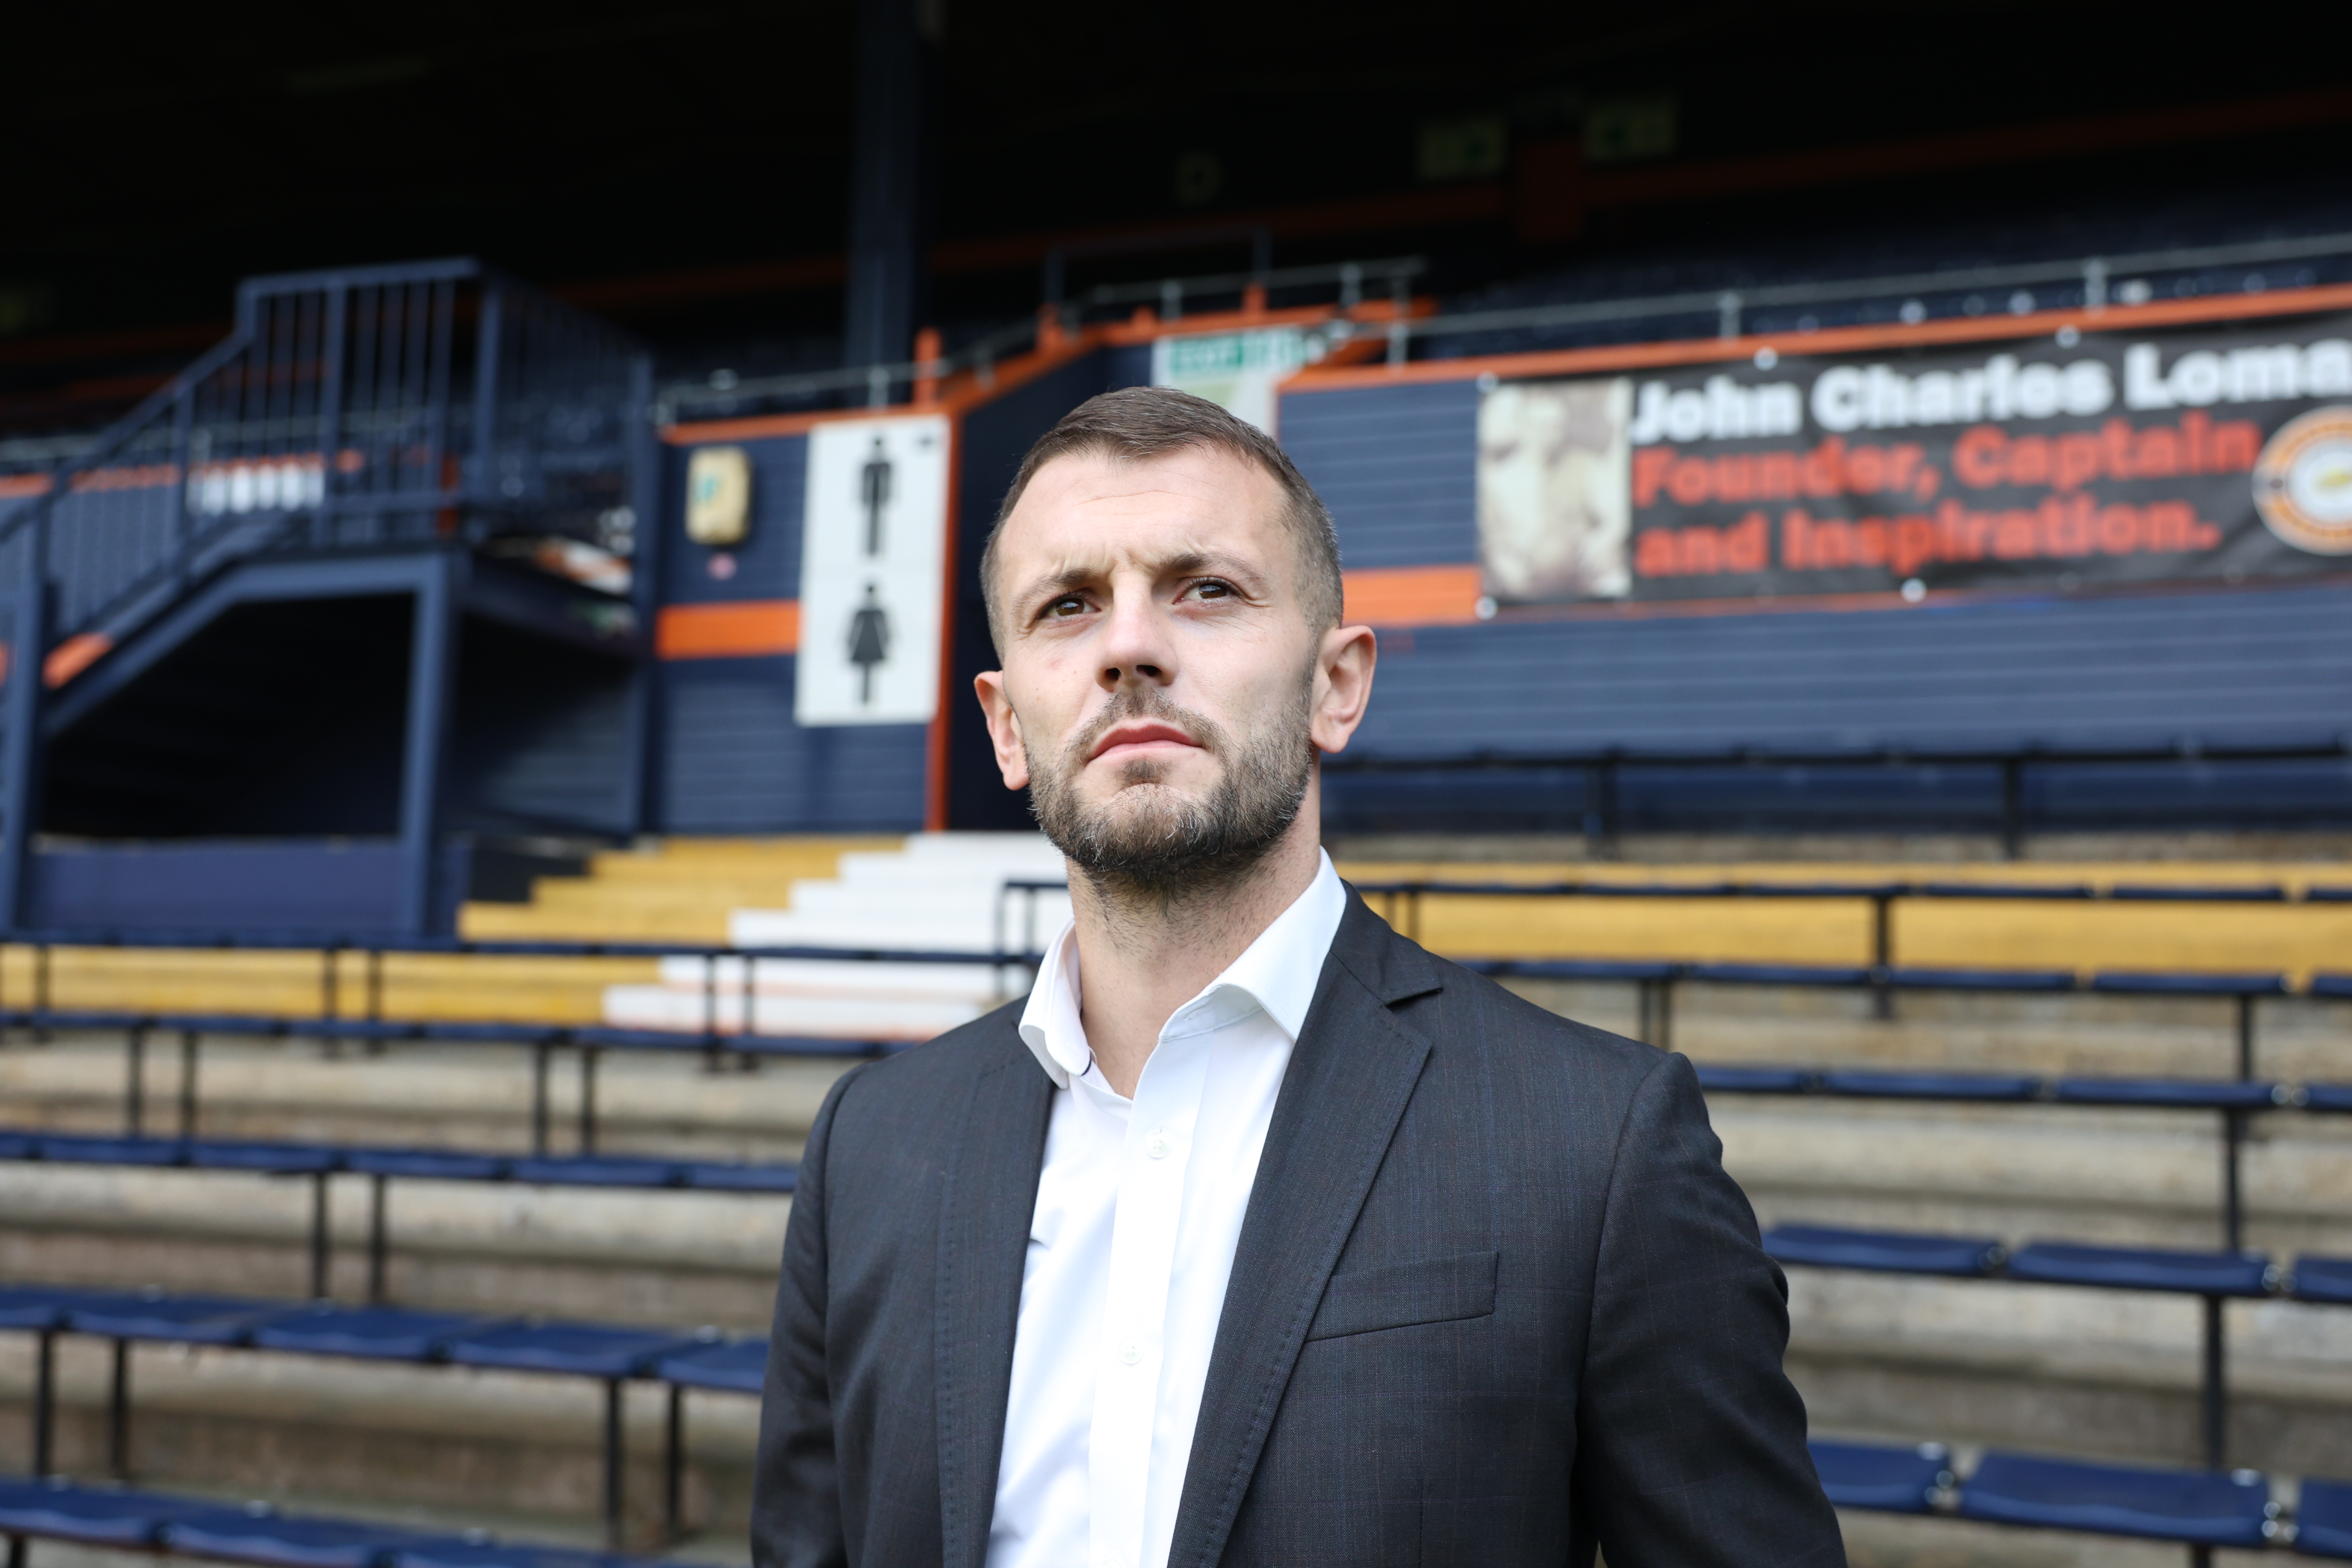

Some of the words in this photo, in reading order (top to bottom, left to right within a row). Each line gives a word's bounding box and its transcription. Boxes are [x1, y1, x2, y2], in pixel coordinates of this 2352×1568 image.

[1630, 376, 1801, 443] John
[1813, 355, 2112, 430] Charles
[1632, 437, 1938, 506] Founder,
[1954, 411, 2259, 490] Captain
[1635, 513, 1765, 575] and
[1784, 494, 2220, 574] Inspiration.
